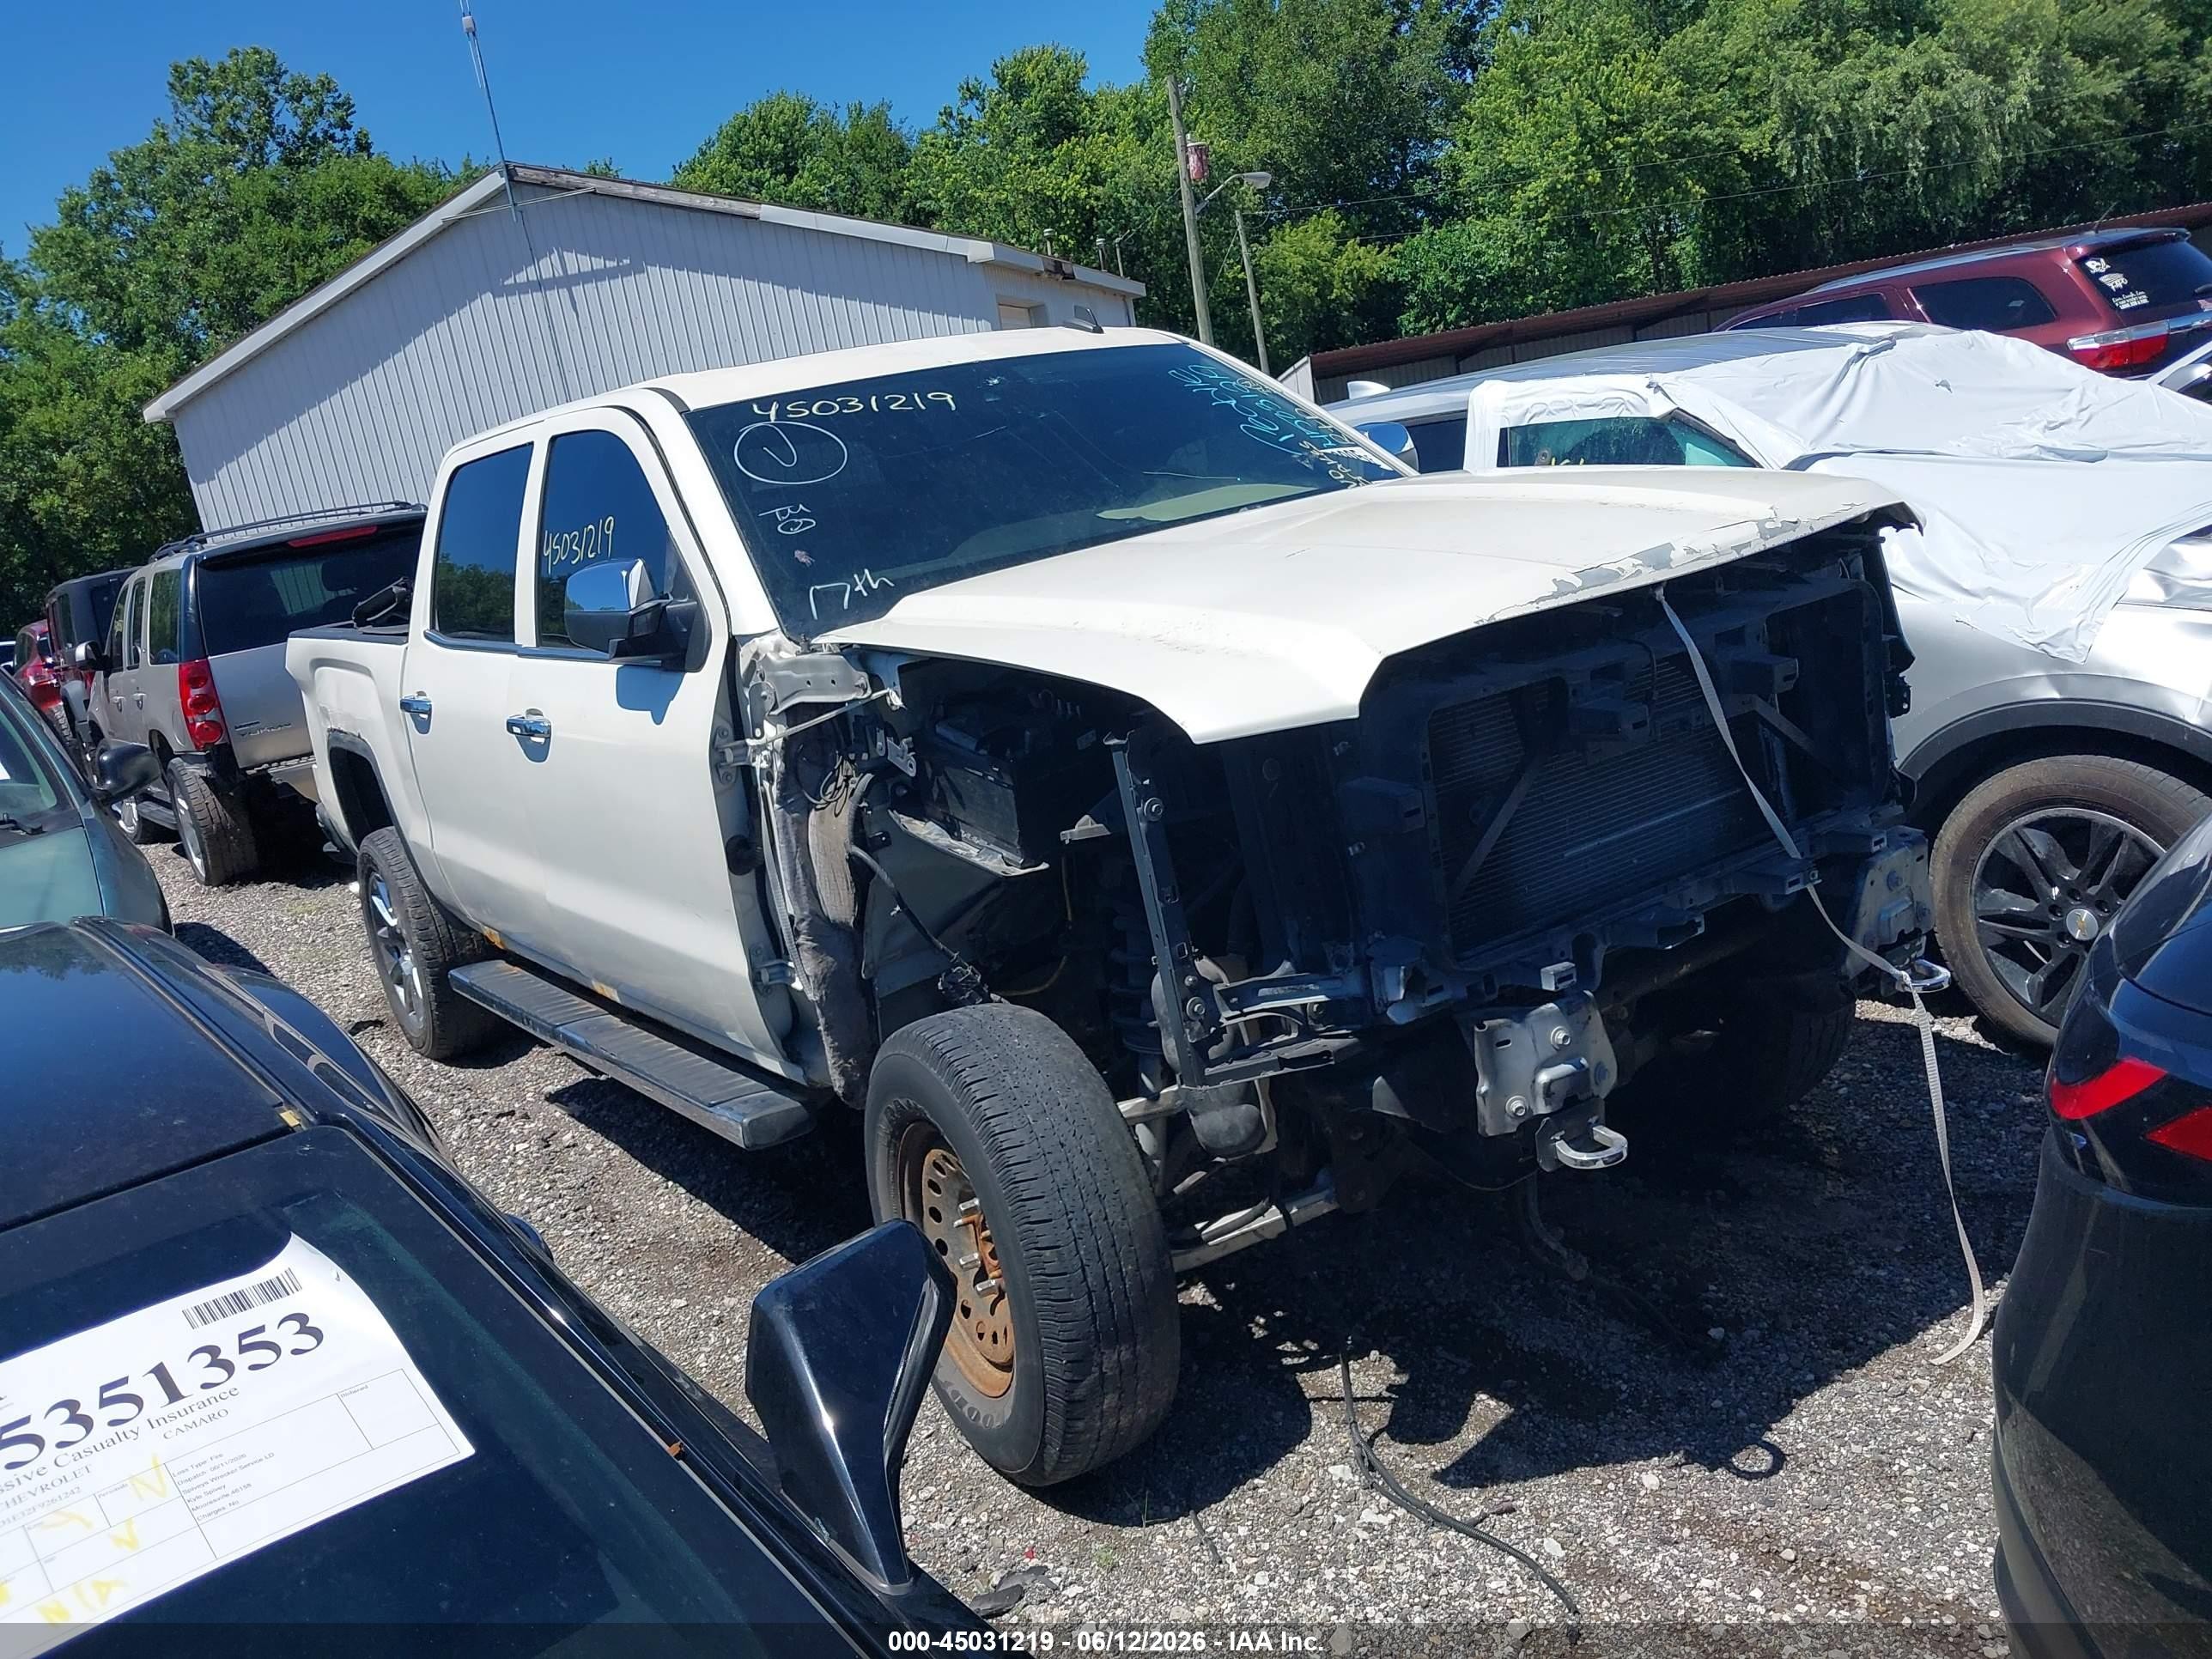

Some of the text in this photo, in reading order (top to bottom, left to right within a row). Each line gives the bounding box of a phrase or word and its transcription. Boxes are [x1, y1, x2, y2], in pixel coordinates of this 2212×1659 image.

[752, 392, 957, 422] 45031219
[543, 515, 615, 575] 45031219
[0, 1407, 230, 1510] HEVROLET CAMARO
[53, 1425, 141, 1468] Casualty
[147, 1386, 240, 1431] Insurance
